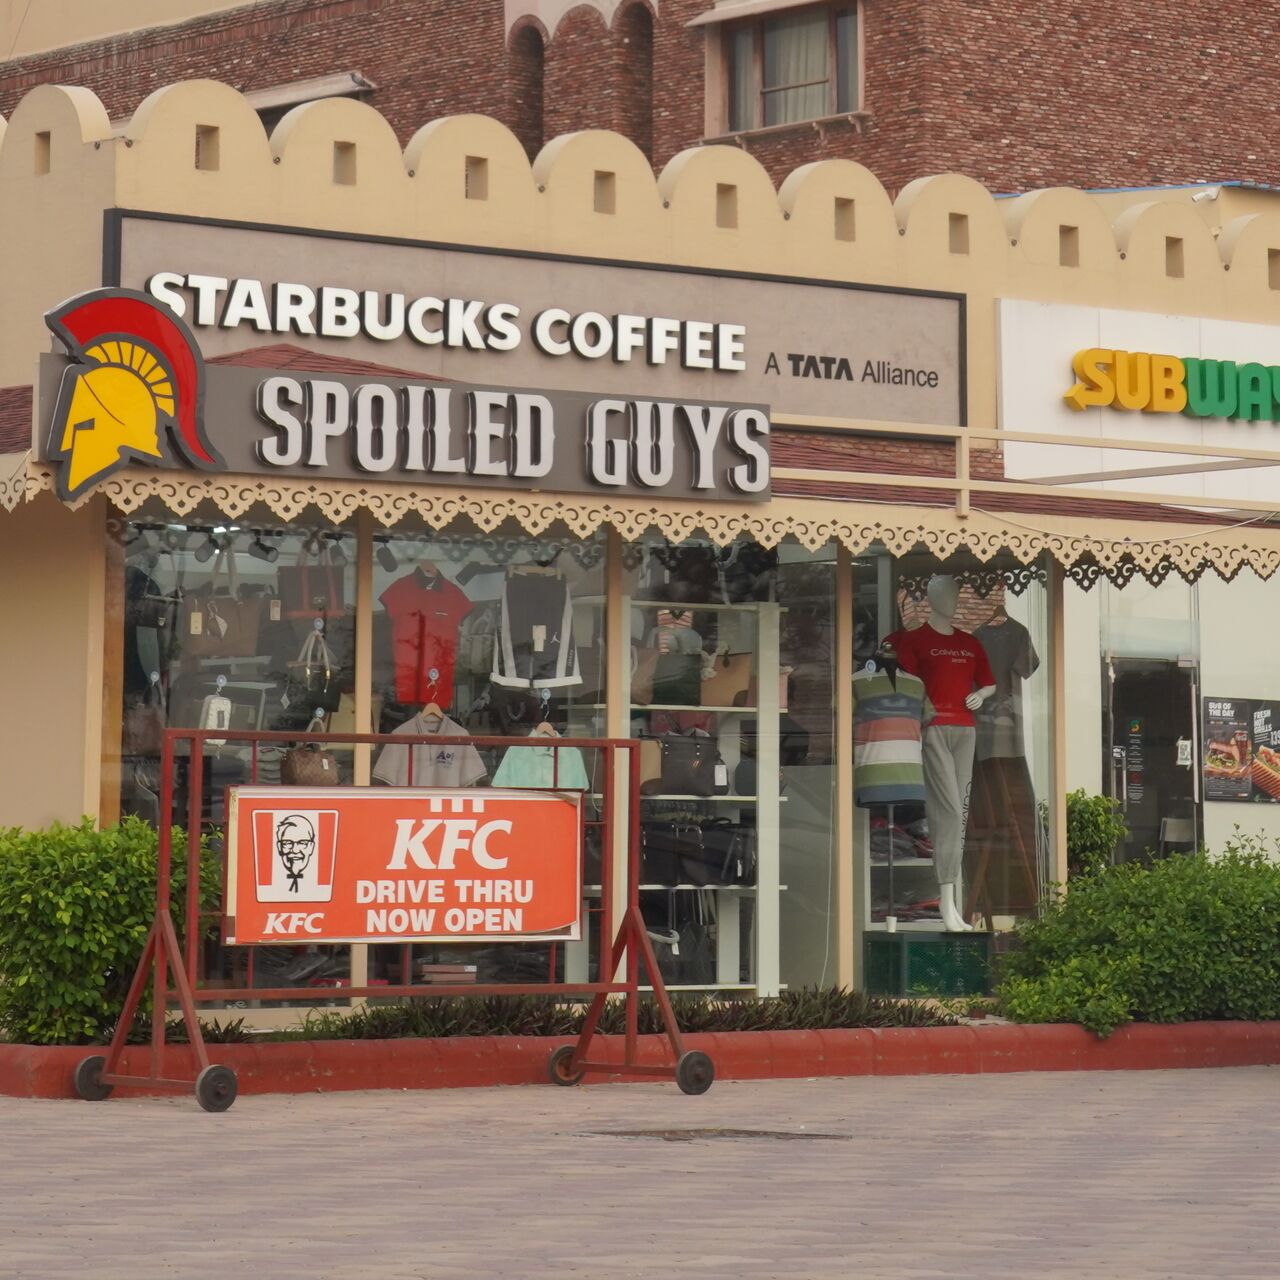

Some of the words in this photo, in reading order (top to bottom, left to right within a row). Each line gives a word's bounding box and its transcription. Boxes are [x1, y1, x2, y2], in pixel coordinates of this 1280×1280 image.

[148, 272, 521, 351] STARBUCKS
[531, 308, 746, 372] COFFEE
[764, 352, 781, 376] A
[788, 353, 854, 382] TATA
[861, 360, 939, 389] Alliance
[255, 376, 556, 478] SPOILED
[585, 399, 770, 493] GUYS
[1209, 709, 1221, 717] THE
[1223, 702, 1232, 710] OF
[1254, 709, 1271, 719] FRESH
[386, 819, 513, 870] KFC
[356, 880, 445, 904] DRIVE
[455, 880, 533, 904] THRU
[262, 912, 324, 934] KFC
[367, 909, 436, 933] NOW
[444, 908, 522, 932] OPEN
